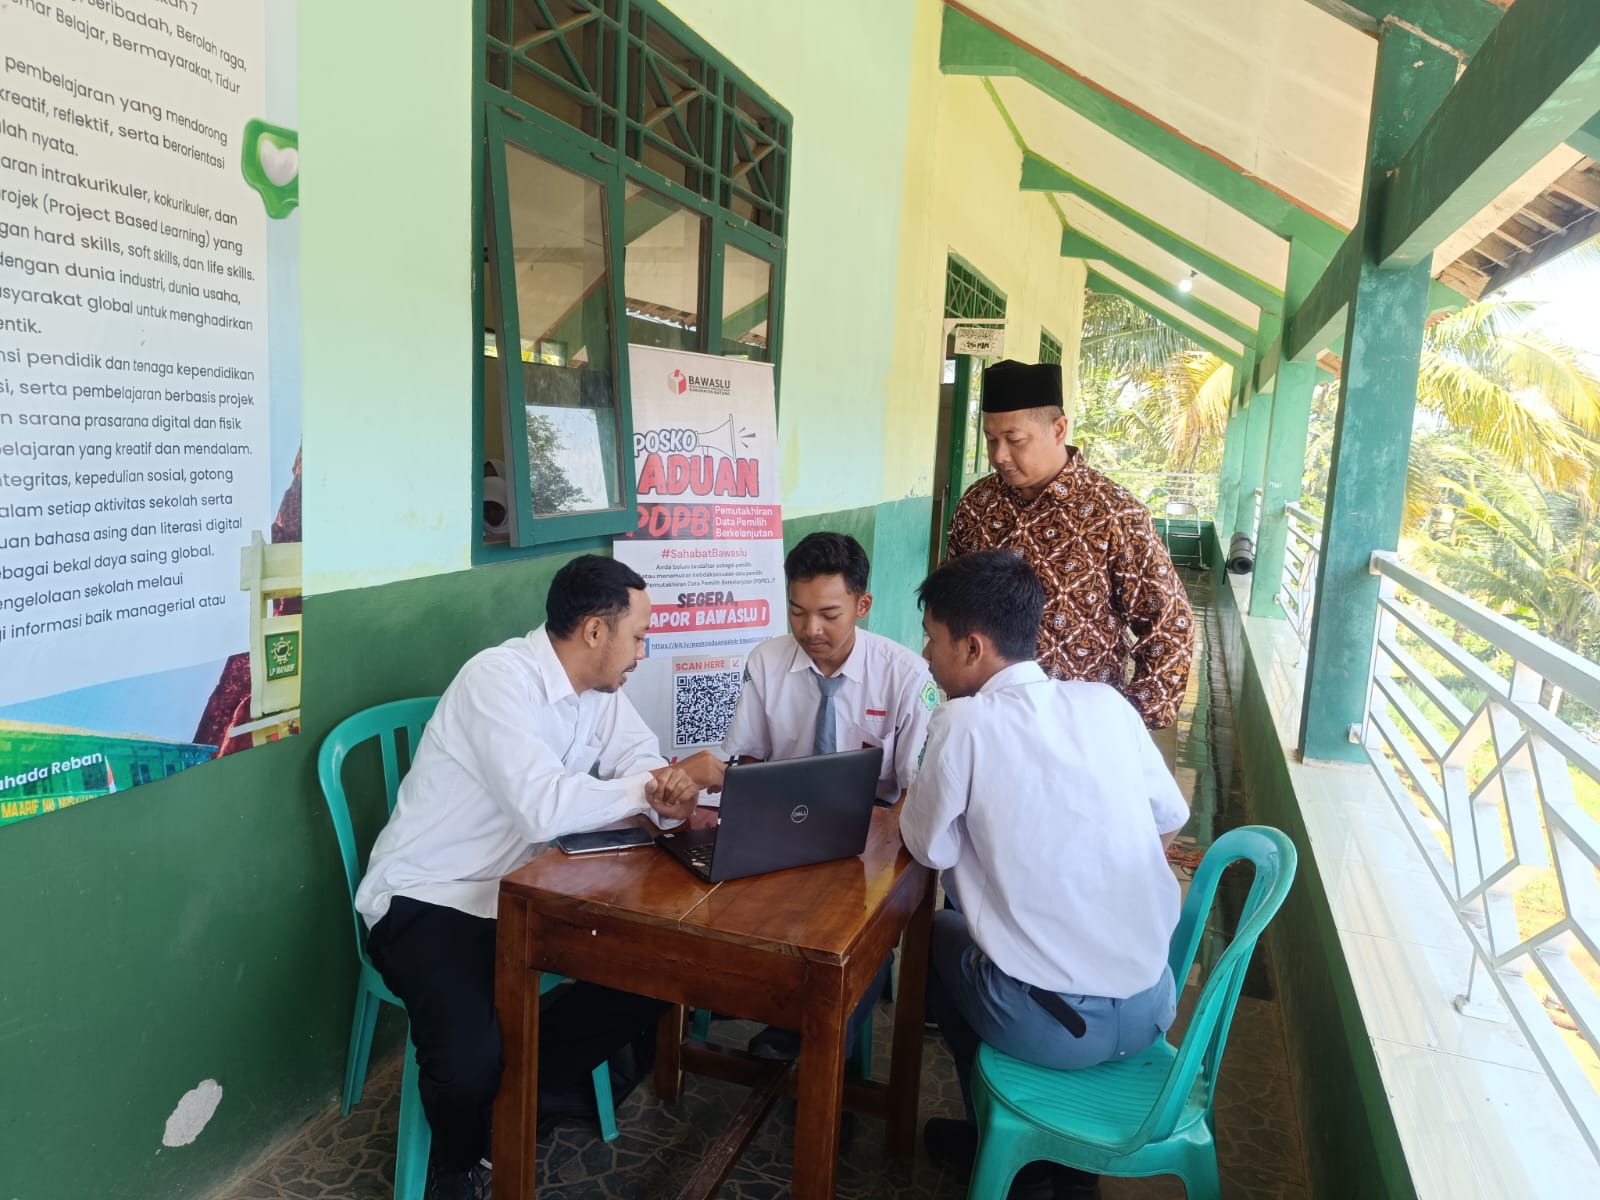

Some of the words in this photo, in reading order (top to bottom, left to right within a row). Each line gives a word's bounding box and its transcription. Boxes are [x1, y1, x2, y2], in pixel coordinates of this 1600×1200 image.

[191, 1, 198, 15] 7
[56, 8, 108, 45] Belajar,
[113, 32, 213, 84] Bermayarakat,
[215, 68, 240, 94] Tidur
[177, 25, 217, 56] Berolah
[220, 49, 247, 72] raga,
[5, 56, 114, 106] pembelajaran
[120, 97, 162, 121] yang
[166, 108, 228, 147] mendorong
[0, 118, 27, 141] lah
[32, 131, 79, 157] nyata.
[53, 106, 114, 136] reflektif,
[118, 126, 159, 146] serta
[163, 135, 225, 169] berorientasi
[41, 163, 151, 203] intrakurikuler,
[154, 190, 212, 221] kokurikuler,
[214, 208, 238, 226] dan
[0, 188, 39, 209] rojek
[43, 193, 111, 223] (Project
[115, 211, 158, 232] Based
[160, 222, 210, 248] Learning)
[213, 234, 243, 256] yang
[34, 226, 75, 247] hard
[80, 234, 124, 256] skills,
[127, 242, 151, 260] soft
[153, 249, 181, 268] skills,
[182, 255, 204, 272] dan
[207, 260, 224, 275] life
[226, 265, 256, 282] skills.
[65, 262, 115, 282] dunia
[119, 270, 166, 293] industri,
[168, 280, 200, 297] dunia
[203, 286, 241, 306] usaha,
[0, 286, 84, 307] syarakat
[87, 294, 133, 314] global
[136, 303, 167, 319] untuk
[169, 309, 254, 331] menghadirkan
[27, 350, 102, 369] pendidik
[105, 355, 131, 371] dan
[133, 361, 174, 377] tenaga
[176, 363, 255, 381] kependidikan
[19, 381, 67, 396] serta
[72, 385, 162, 404] pembelajaran
[165, 389, 216, 404] berbasis
[219, 393, 254, 408] projek
[688, 375, 731, 389] BAWASLU
[18, 413, 80, 427] sarana
[84, 415, 149, 430] prasarana
[151, 415, 191, 432] digital
[193, 416, 216, 430] dan
[219, 416, 242, 430] fisik
[0, 441, 75, 460] elajaran
[79, 443, 112, 460] yang
[115, 441, 152, 455] kreatif
[155, 441, 180, 455] dan
[184, 442, 253, 456] mendalam.
[634, 428, 697, 456] POSKO
[0, 472, 71, 491] tegritas,
[75, 469, 144, 488] kepedulian
[147, 468, 187, 482] sosial,
[189, 468, 233, 484] gotong
[637, 453, 759, 498] ADUAN
[47, 500, 91, 517] setiap
[94, 497, 146, 512] aktivitas
[149, 494, 198, 509] sekolah
[201, 493, 233, 506] serta
[715, 506, 773, 515] Pemutakhiran
[35, 530, 90, 546] bahasa
[93, 525, 128, 541] asing
[130, 522, 157, 536] dan
[160, 519, 202, 534] literasi
[206, 517, 243, 533] digital
[715, 518, 735, 526] Data
[737, 518, 767, 526] Pemilih
[716, 529, 773, 539] Berkelanjutan
[0, 561, 49, 581] bagai
[53, 555, 91, 574] bekal
[94, 552, 127, 569] daya
[130, 548, 167, 564] saing
[171, 544, 215, 563] global.
[662, 548, 747, 559] #SahabatBawaslu
[84, 580, 134, 599] sekolah
[137, 573, 183, 590] melaui
[11, 614, 82, 638] informasi
[86, 610, 113, 625] baik
[116, 597, 195, 617] managerial
[199, 594, 226, 608] atau
[649, 611, 690, 628] APOR
[696, 608, 757, 625] BAWASLU
[675, 661, 703, 671] SCAN
[704, 660, 726, 669] HERE
[51, 752, 103, 774] Reban
[793, 810, 806, 818] DELL
